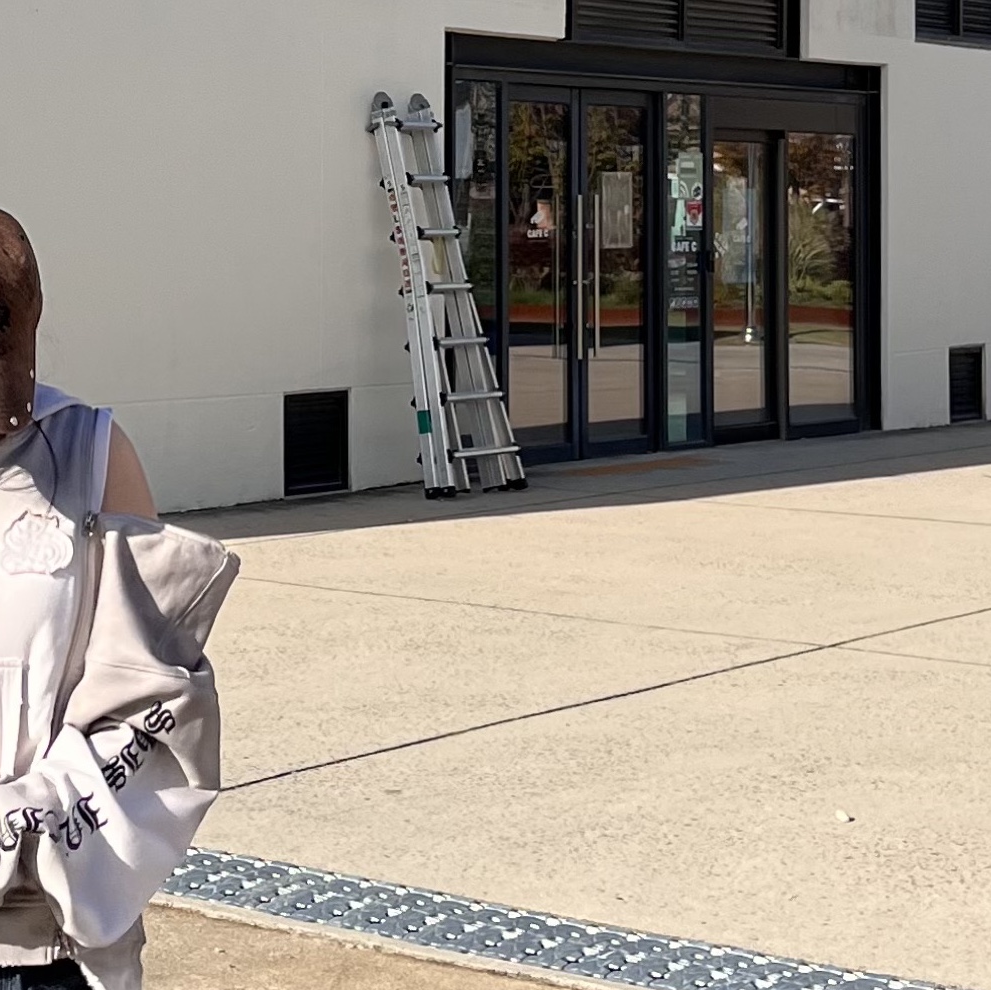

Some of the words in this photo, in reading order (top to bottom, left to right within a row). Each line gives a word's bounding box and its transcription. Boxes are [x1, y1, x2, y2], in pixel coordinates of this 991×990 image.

[527, 229, 543, 239] CAFE
[671, 241, 690, 252] CAFE
[691, 241, 698, 252] C
